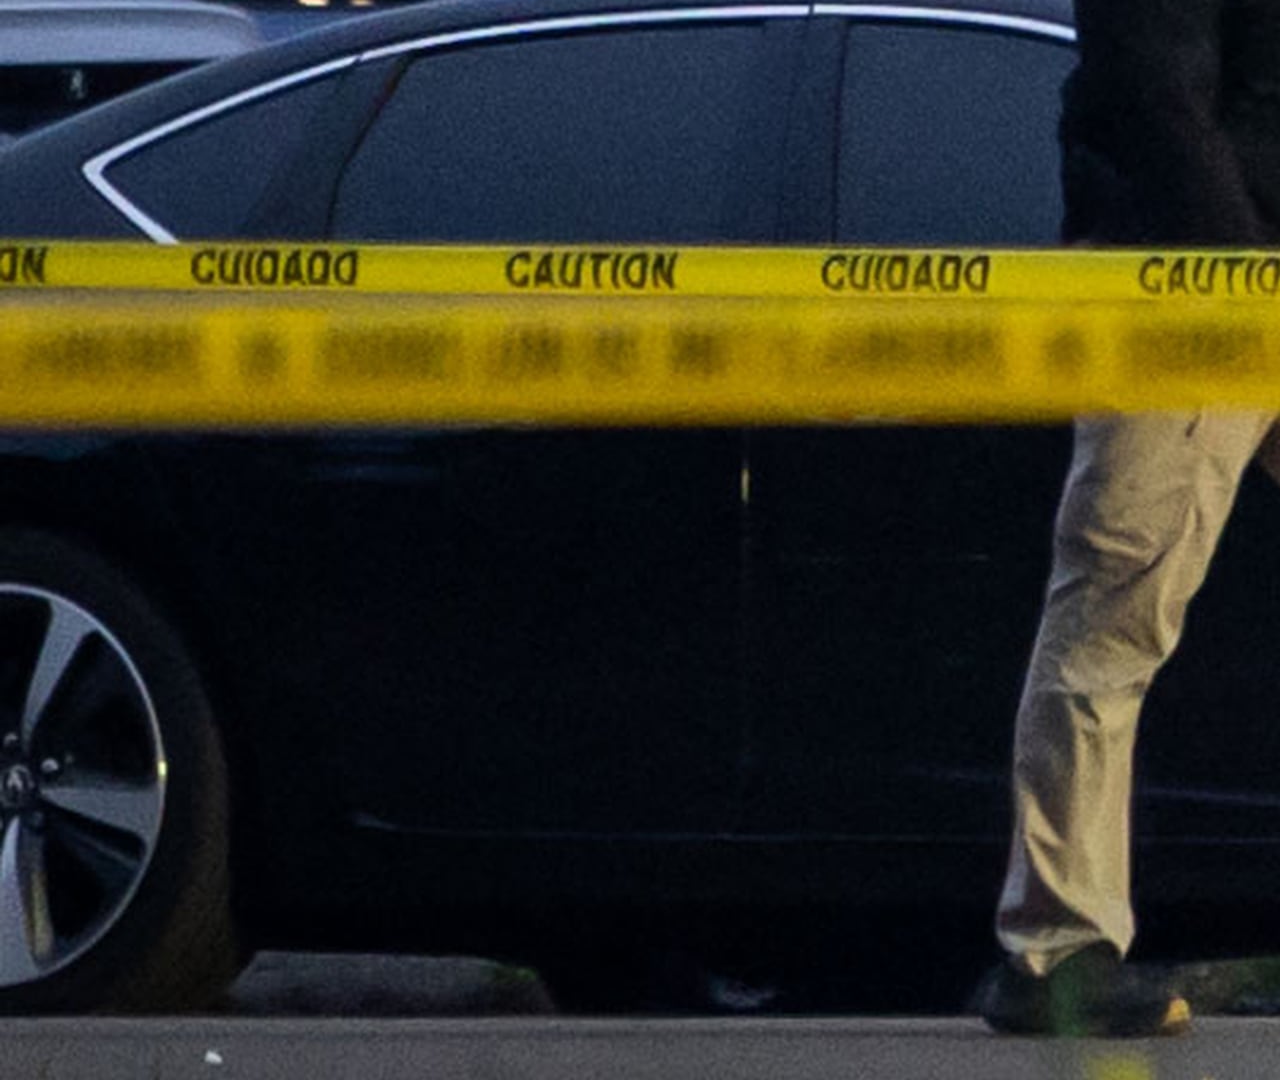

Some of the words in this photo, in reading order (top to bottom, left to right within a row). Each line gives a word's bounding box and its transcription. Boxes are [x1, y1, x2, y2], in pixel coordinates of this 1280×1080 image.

[190, 249, 359, 287] CUIDADO
[504, 251, 679, 289] CAUTION
[820, 253, 991, 292] CUIDADO
